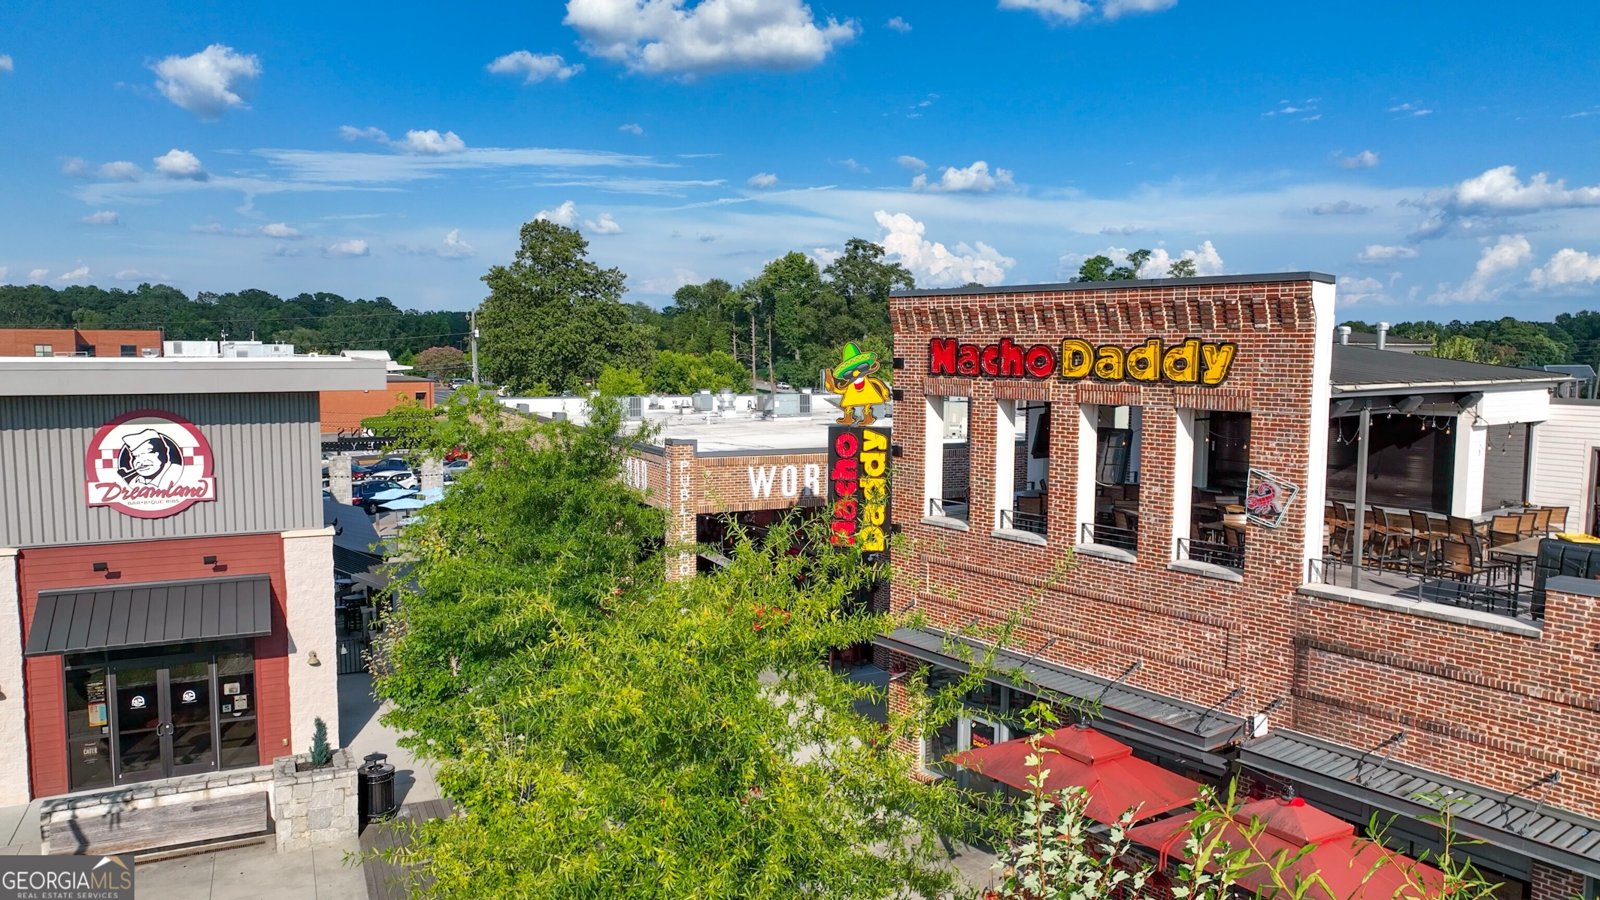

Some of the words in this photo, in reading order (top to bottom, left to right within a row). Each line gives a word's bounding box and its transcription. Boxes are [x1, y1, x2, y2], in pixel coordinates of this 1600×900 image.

[929, 336, 1056, 379] Nacho
[1061, 336, 1238, 387] Daddy
[95, 480, 209, 502] Dreamland
[748, 463, 829, 499] WOR
[831, 431, 859, 546] Nacho
[860, 429, 888, 552] Daddy
